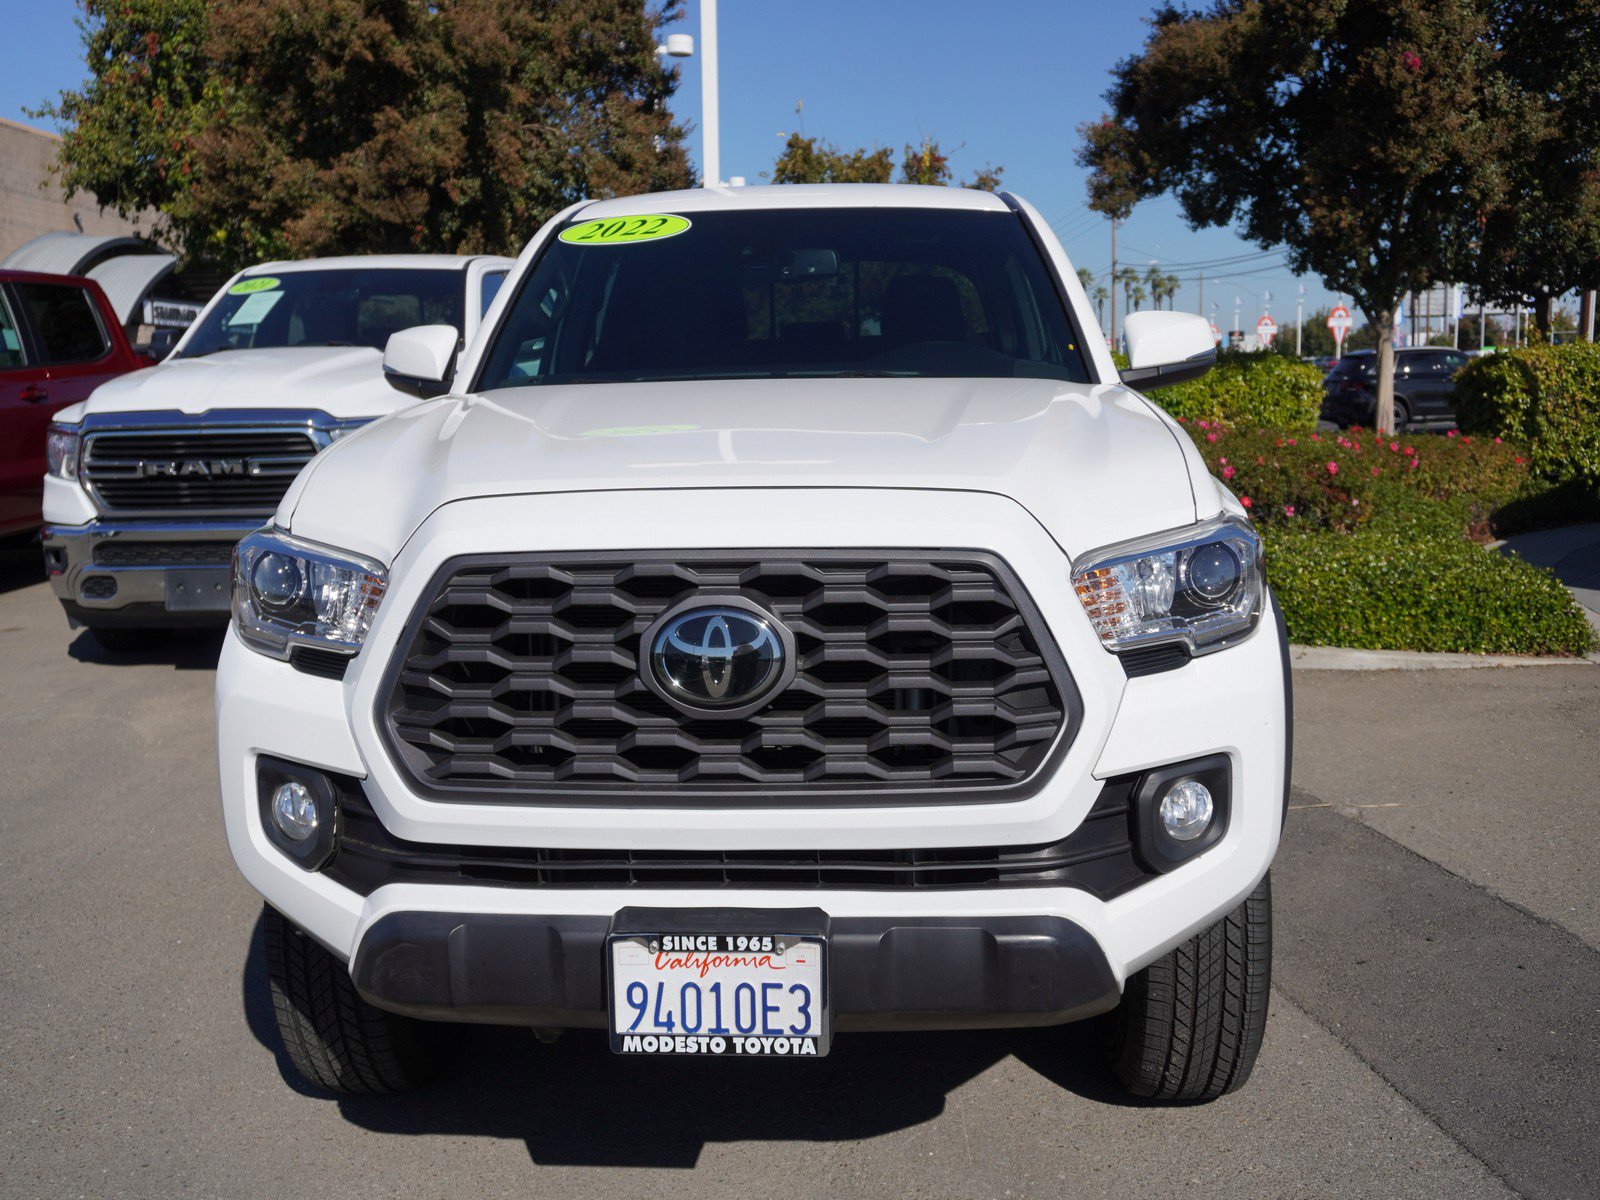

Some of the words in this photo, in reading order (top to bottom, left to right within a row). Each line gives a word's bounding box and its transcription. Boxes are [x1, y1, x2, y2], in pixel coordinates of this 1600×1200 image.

[576, 218, 668, 240] 2022
[147, 459, 243, 477] RAM
[662, 936, 717, 951] SINCE
[725, 937, 773, 951] 1965
[654, 951, 786, 978] California
[626, 981, 812, 1035] 94010E3
[623, 1036, 727, 1053] MODESTO
[733, 1037, 817, 1055] TOYOTA
